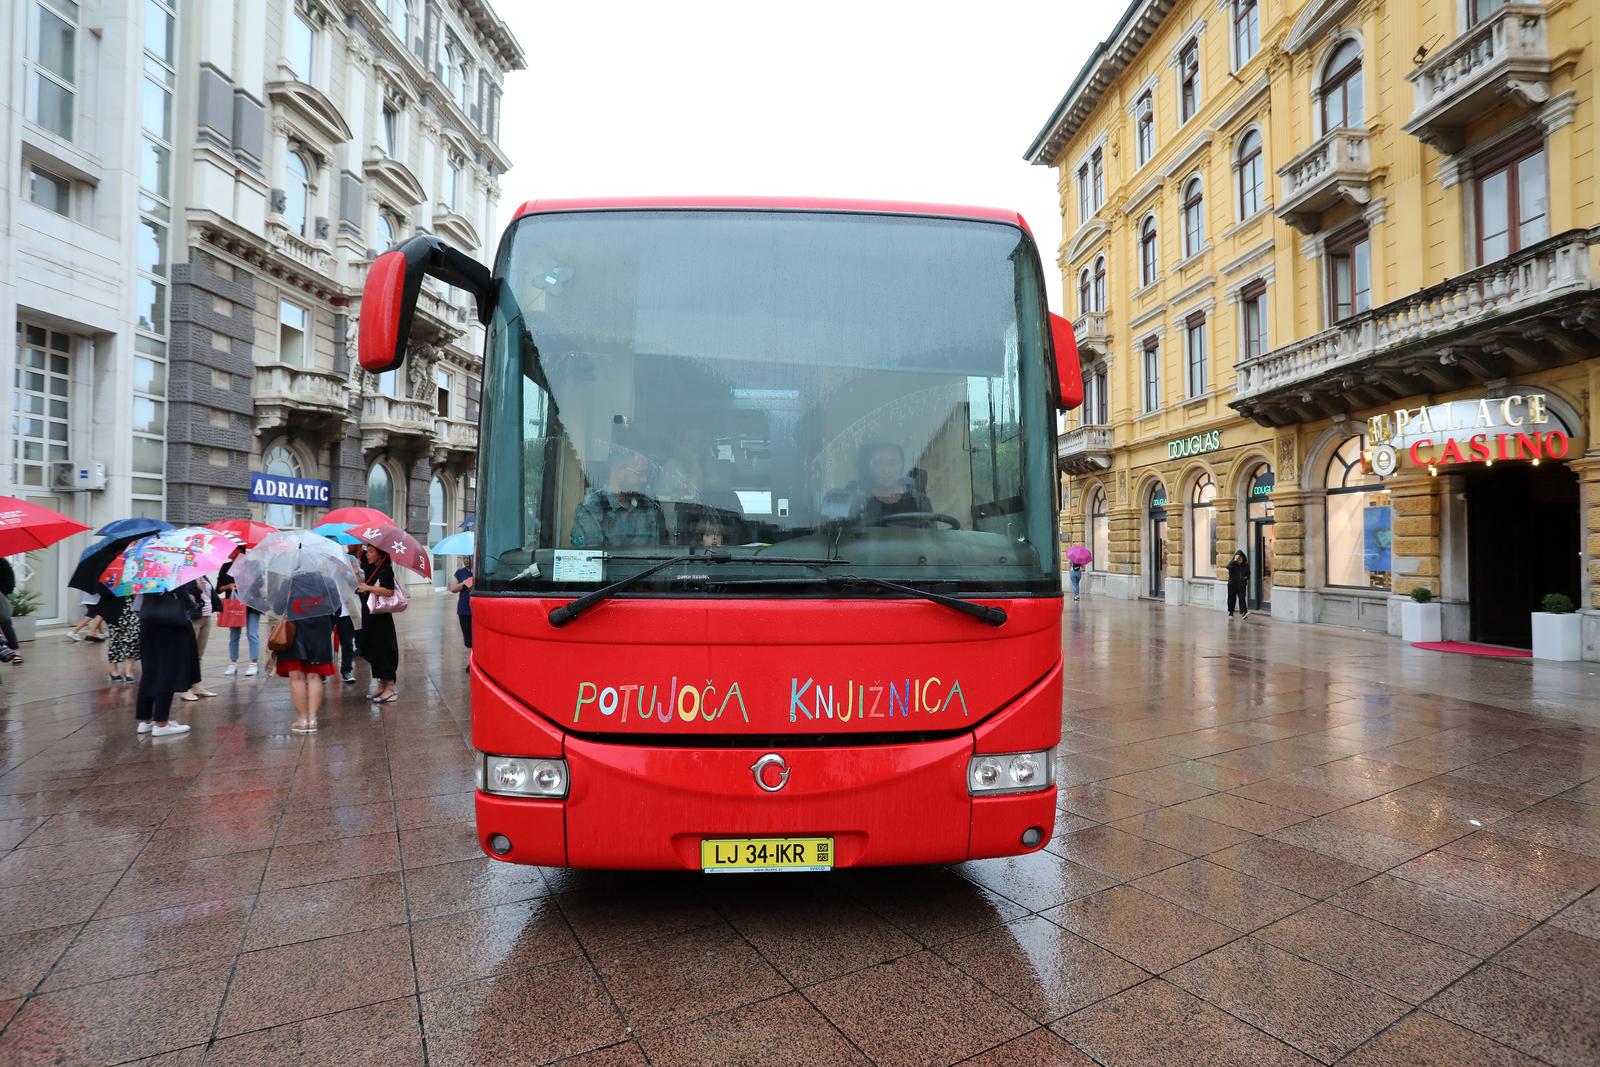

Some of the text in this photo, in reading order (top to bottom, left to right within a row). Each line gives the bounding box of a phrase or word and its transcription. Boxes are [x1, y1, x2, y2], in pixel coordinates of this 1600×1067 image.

[1394, 394, 1549, 437] PALACE
[1168, 430, 1220, 459] DOUGLAS
[1409, 430, 1569, 467] CASINO
[253, 479, 329, 501] ADRIATIC
[573, 676, 968, 723] POTUJOČA KNJIŽNICA
[715, 843, 805, 864] LJ 34-IKR
